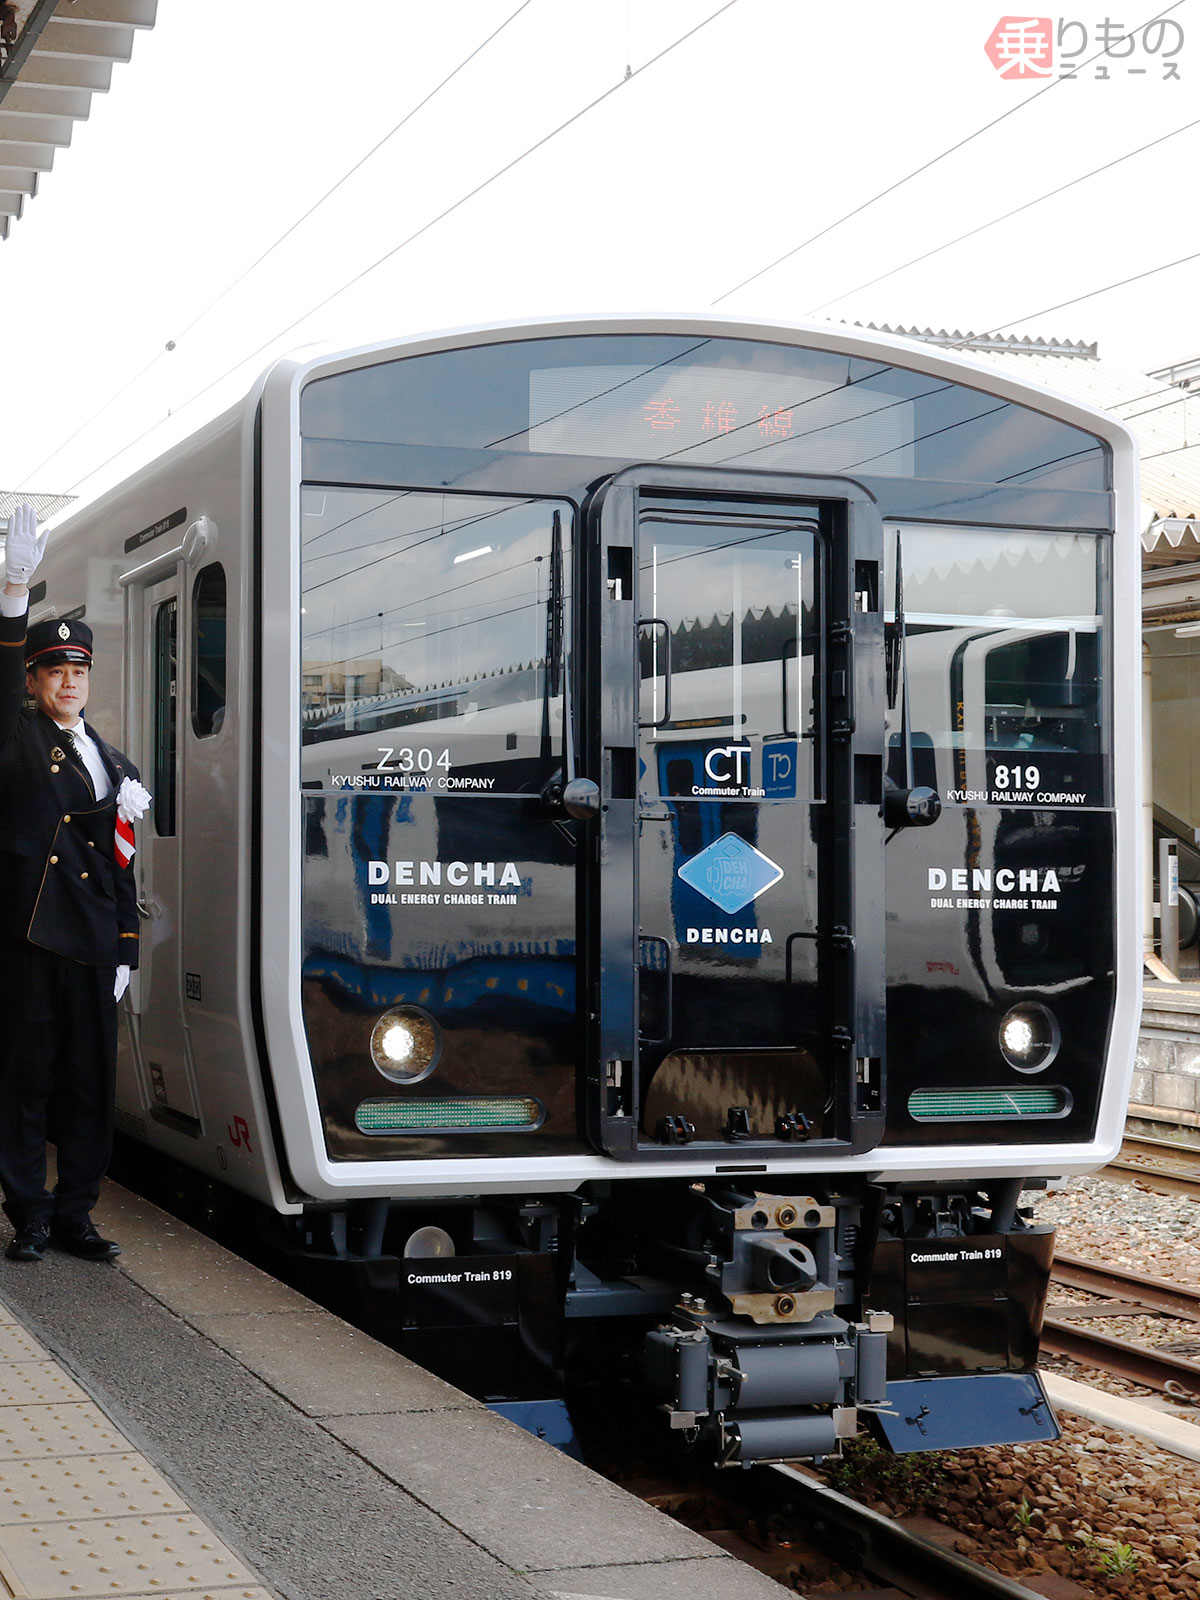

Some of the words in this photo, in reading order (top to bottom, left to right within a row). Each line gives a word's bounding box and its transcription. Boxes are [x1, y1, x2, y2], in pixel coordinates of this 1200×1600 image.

[377, 748, 452, 772] Z304
[704, 746, 752, 784] CT
[331, 775, 381, 787] KYUSHU
[384, 776, 434, 788] RAILWAY
[437, 778, 496, 789] COMPANY
[994, 765, 1041, 790] 819
[691, 785, 740, 796] Commuter
[742, 787, 766, 796] Train
[947, 790, 989, 801] KYUSHU
[991, 791, 1034, 802] RAILWAY
[1036, 792, 1087, 803] COMPANY
[368, 861, 521, 887] DENCHA
[722, 860, 748, 874] DEN
[723, 875, 748, 890] CHA
[928, 868, 1061, 893] DENCHA
[371, 894, 398, 904] DUAL
[401, 894, 440, 905] ENERGY
[443, 894, 484, 905] CHARGE
[487, 894, 517, 905] TRAIN
[931, 898, 954, 908] DUAL
[956, 899, 991, 909] ENERGY
[993, 899, 1029, 909] CHARGE
[1031, 899, 1057, 910] TRAIN
[686, 928, 773, 944] DENCHA
[228, 1114, 253, 1153] JR
[910, 1252, 958, 1263] Commuter
[960, 1250, 983, 1260] Train
[984, 1248, 1002, 1259] 819
[407, 1273, 462, 1284] Commuter
[464, 1271, 490, 1282] Train
[492, 1270, 512, 1280] 819
